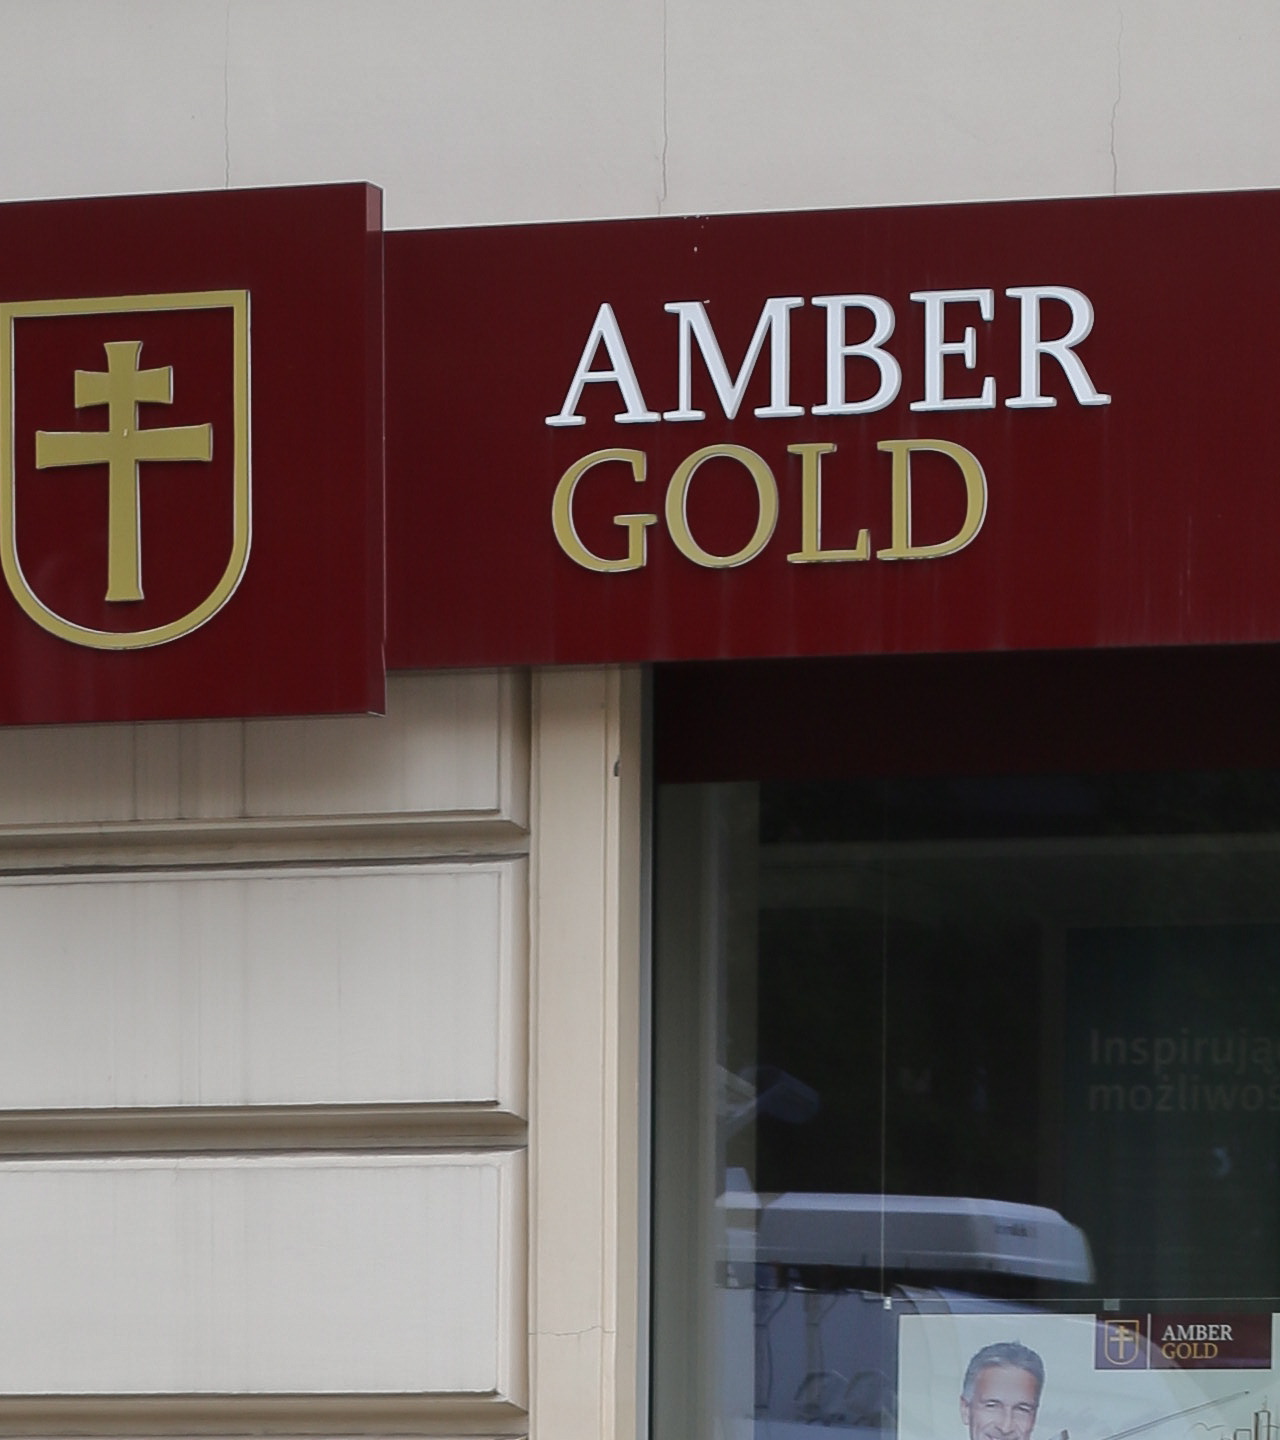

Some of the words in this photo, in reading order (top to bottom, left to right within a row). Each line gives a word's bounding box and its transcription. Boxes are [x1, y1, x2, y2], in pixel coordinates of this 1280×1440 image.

[545, 285, 1111, 426] AMBER
[551, 438, 988, 573] GOLD
[1161, 1324, 1234, 1341] AMBER
[1162, 1343, 1218, 1359] GOLD
